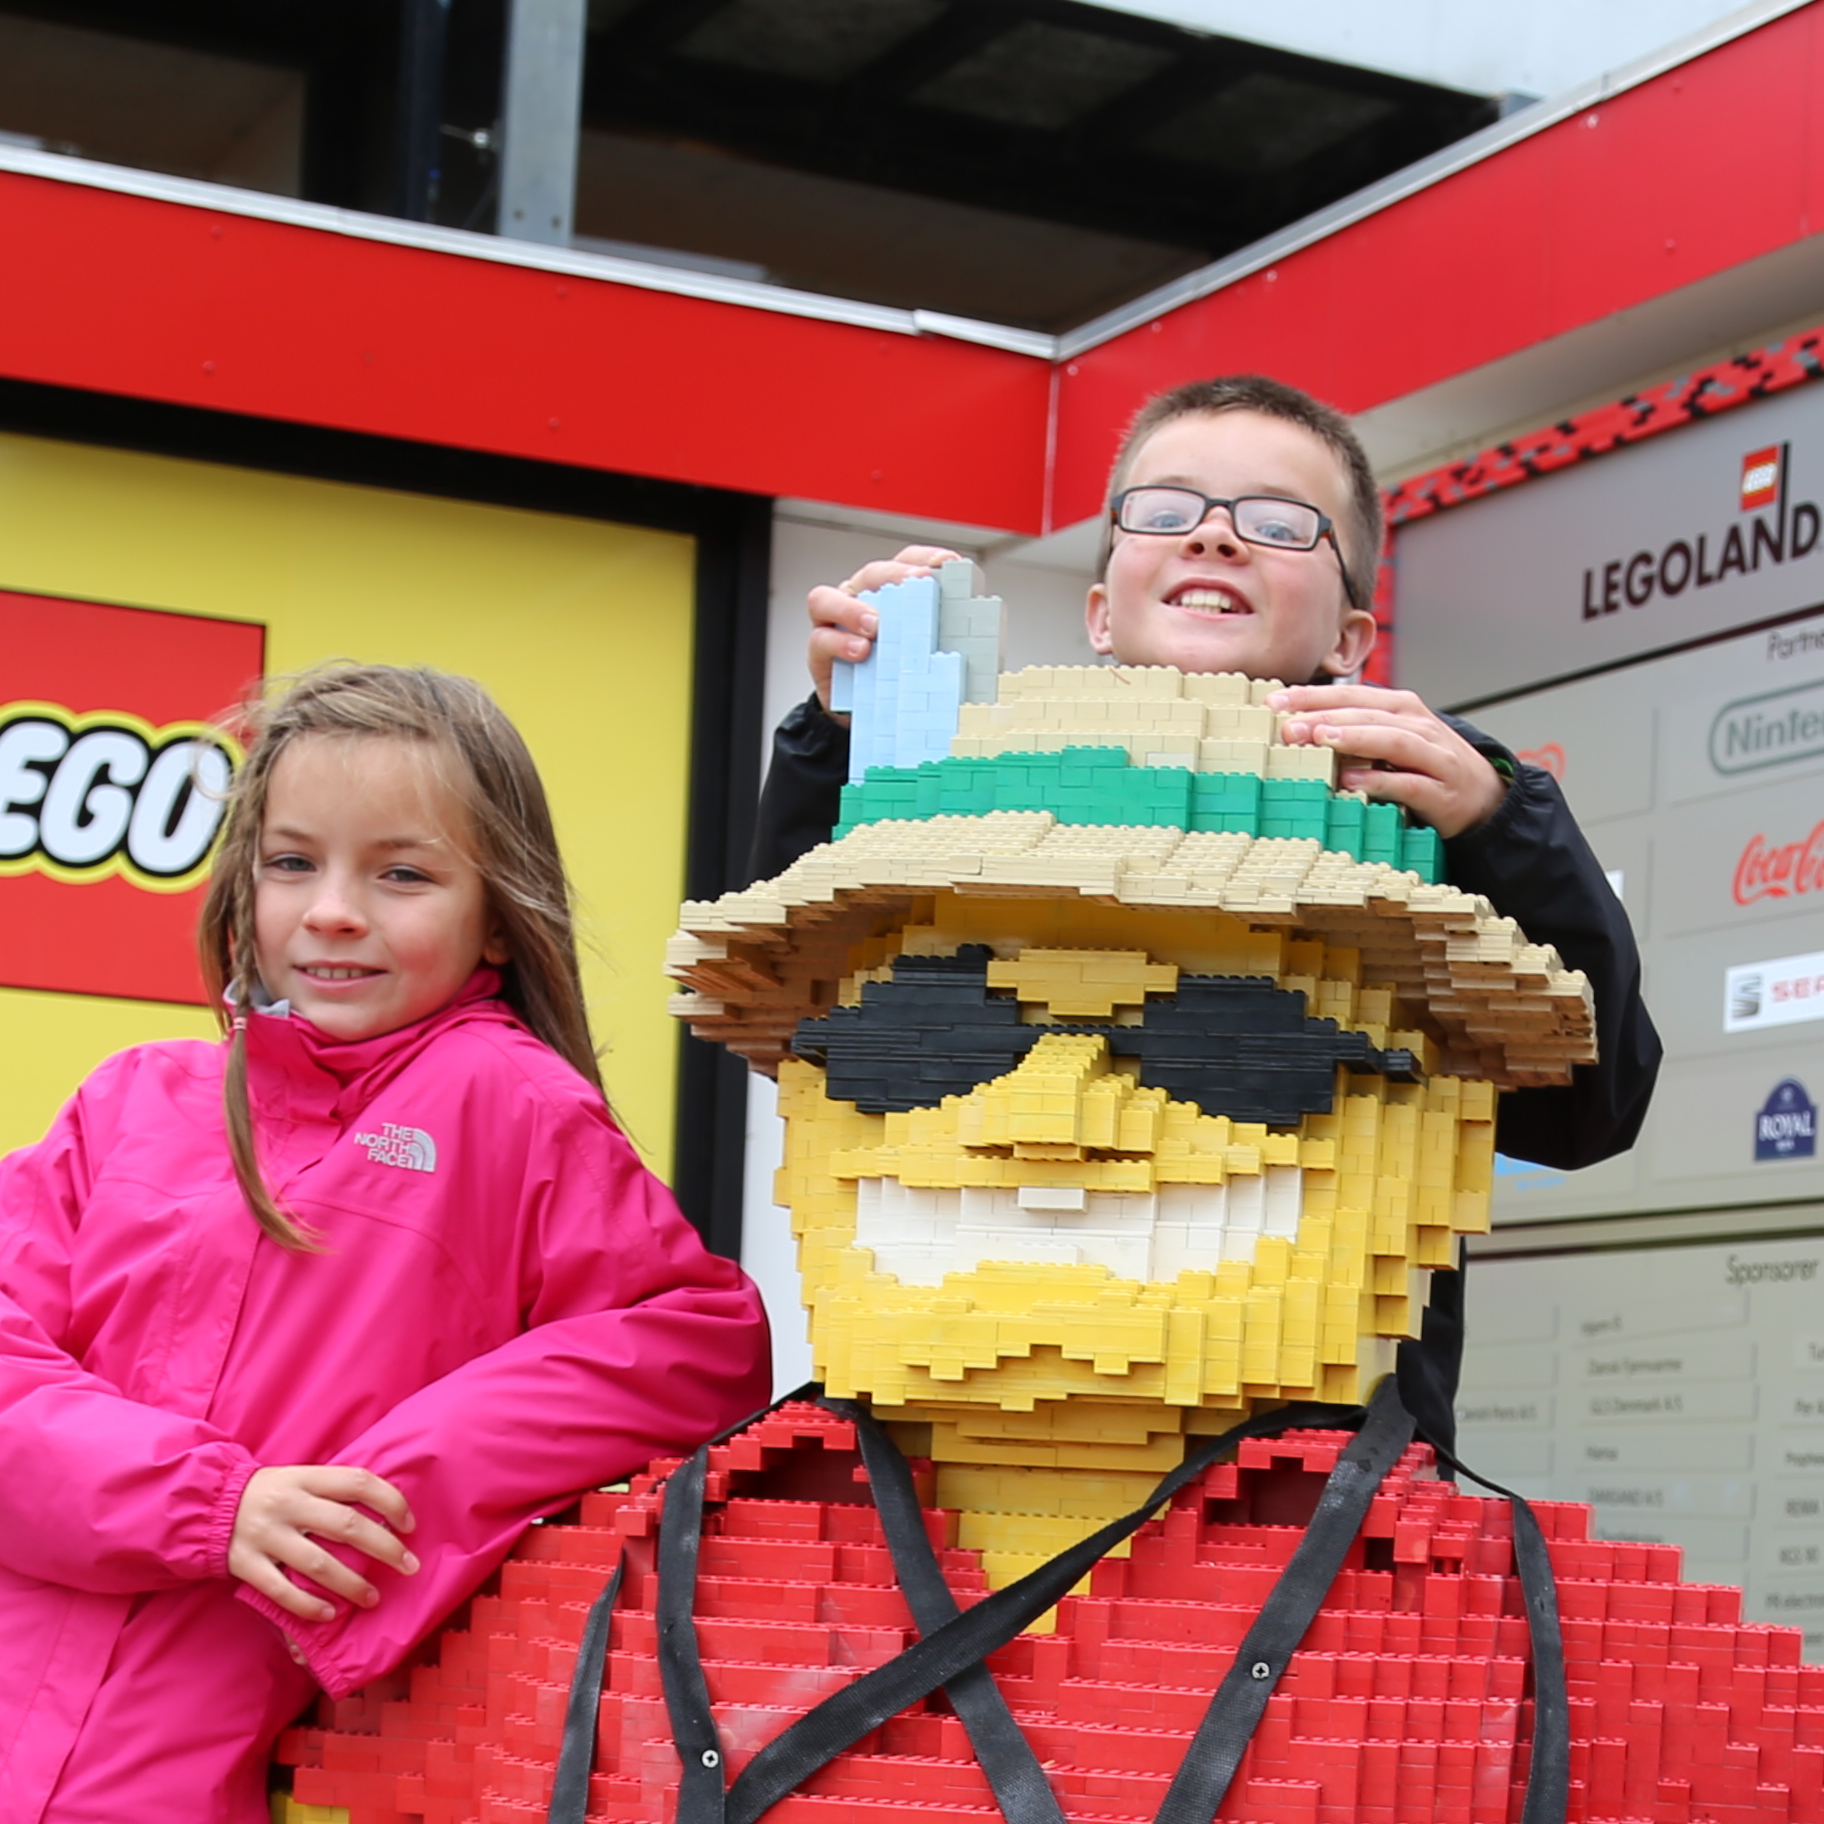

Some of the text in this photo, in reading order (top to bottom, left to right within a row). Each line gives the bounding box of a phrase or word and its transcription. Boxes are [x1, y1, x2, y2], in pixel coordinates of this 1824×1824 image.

[1581, 441, 1822, 621] LEGOLAND
[382, 1122, 414, 1141] THE
[1758, 1110, 1815, 1141] ROYAL
[354, 1133, 410, 1155] NORTH
[367, 1147, 409, 1169] FACE
[1726, 1255, 1819, 1287] Sponsorer
